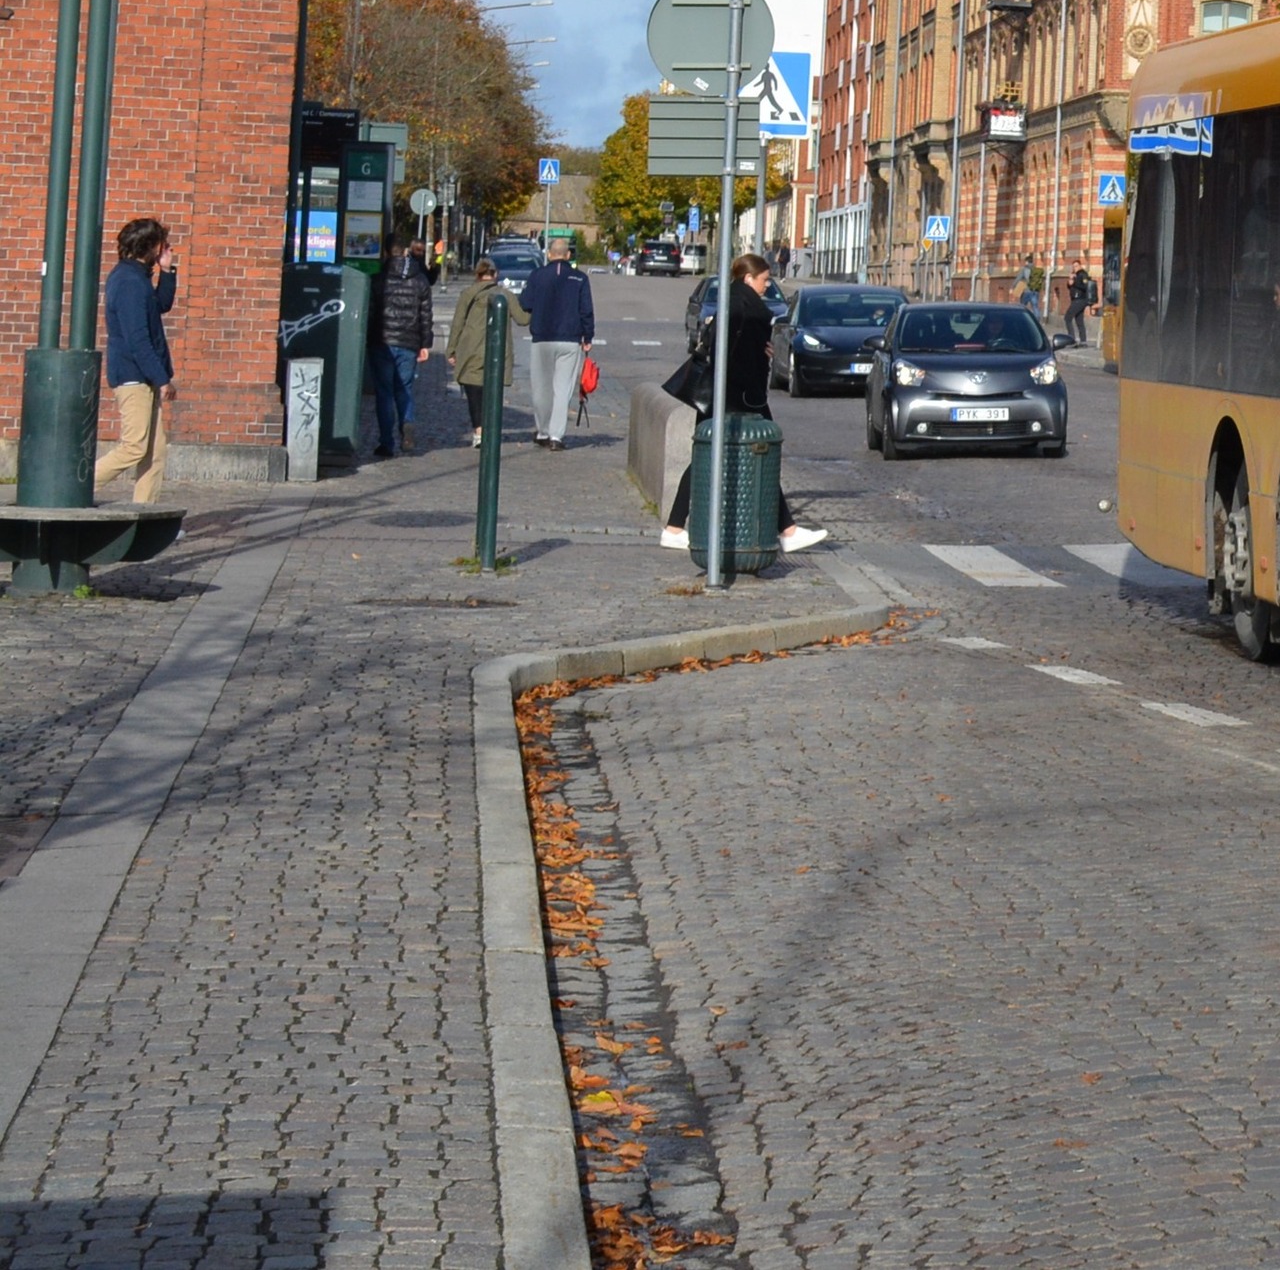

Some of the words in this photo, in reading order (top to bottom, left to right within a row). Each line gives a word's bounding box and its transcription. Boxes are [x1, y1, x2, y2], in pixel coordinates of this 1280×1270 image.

[361, 162, 371, 176] G
[958, 410, 979, 420] PYK
[986, 409, 1006, 419] 391
